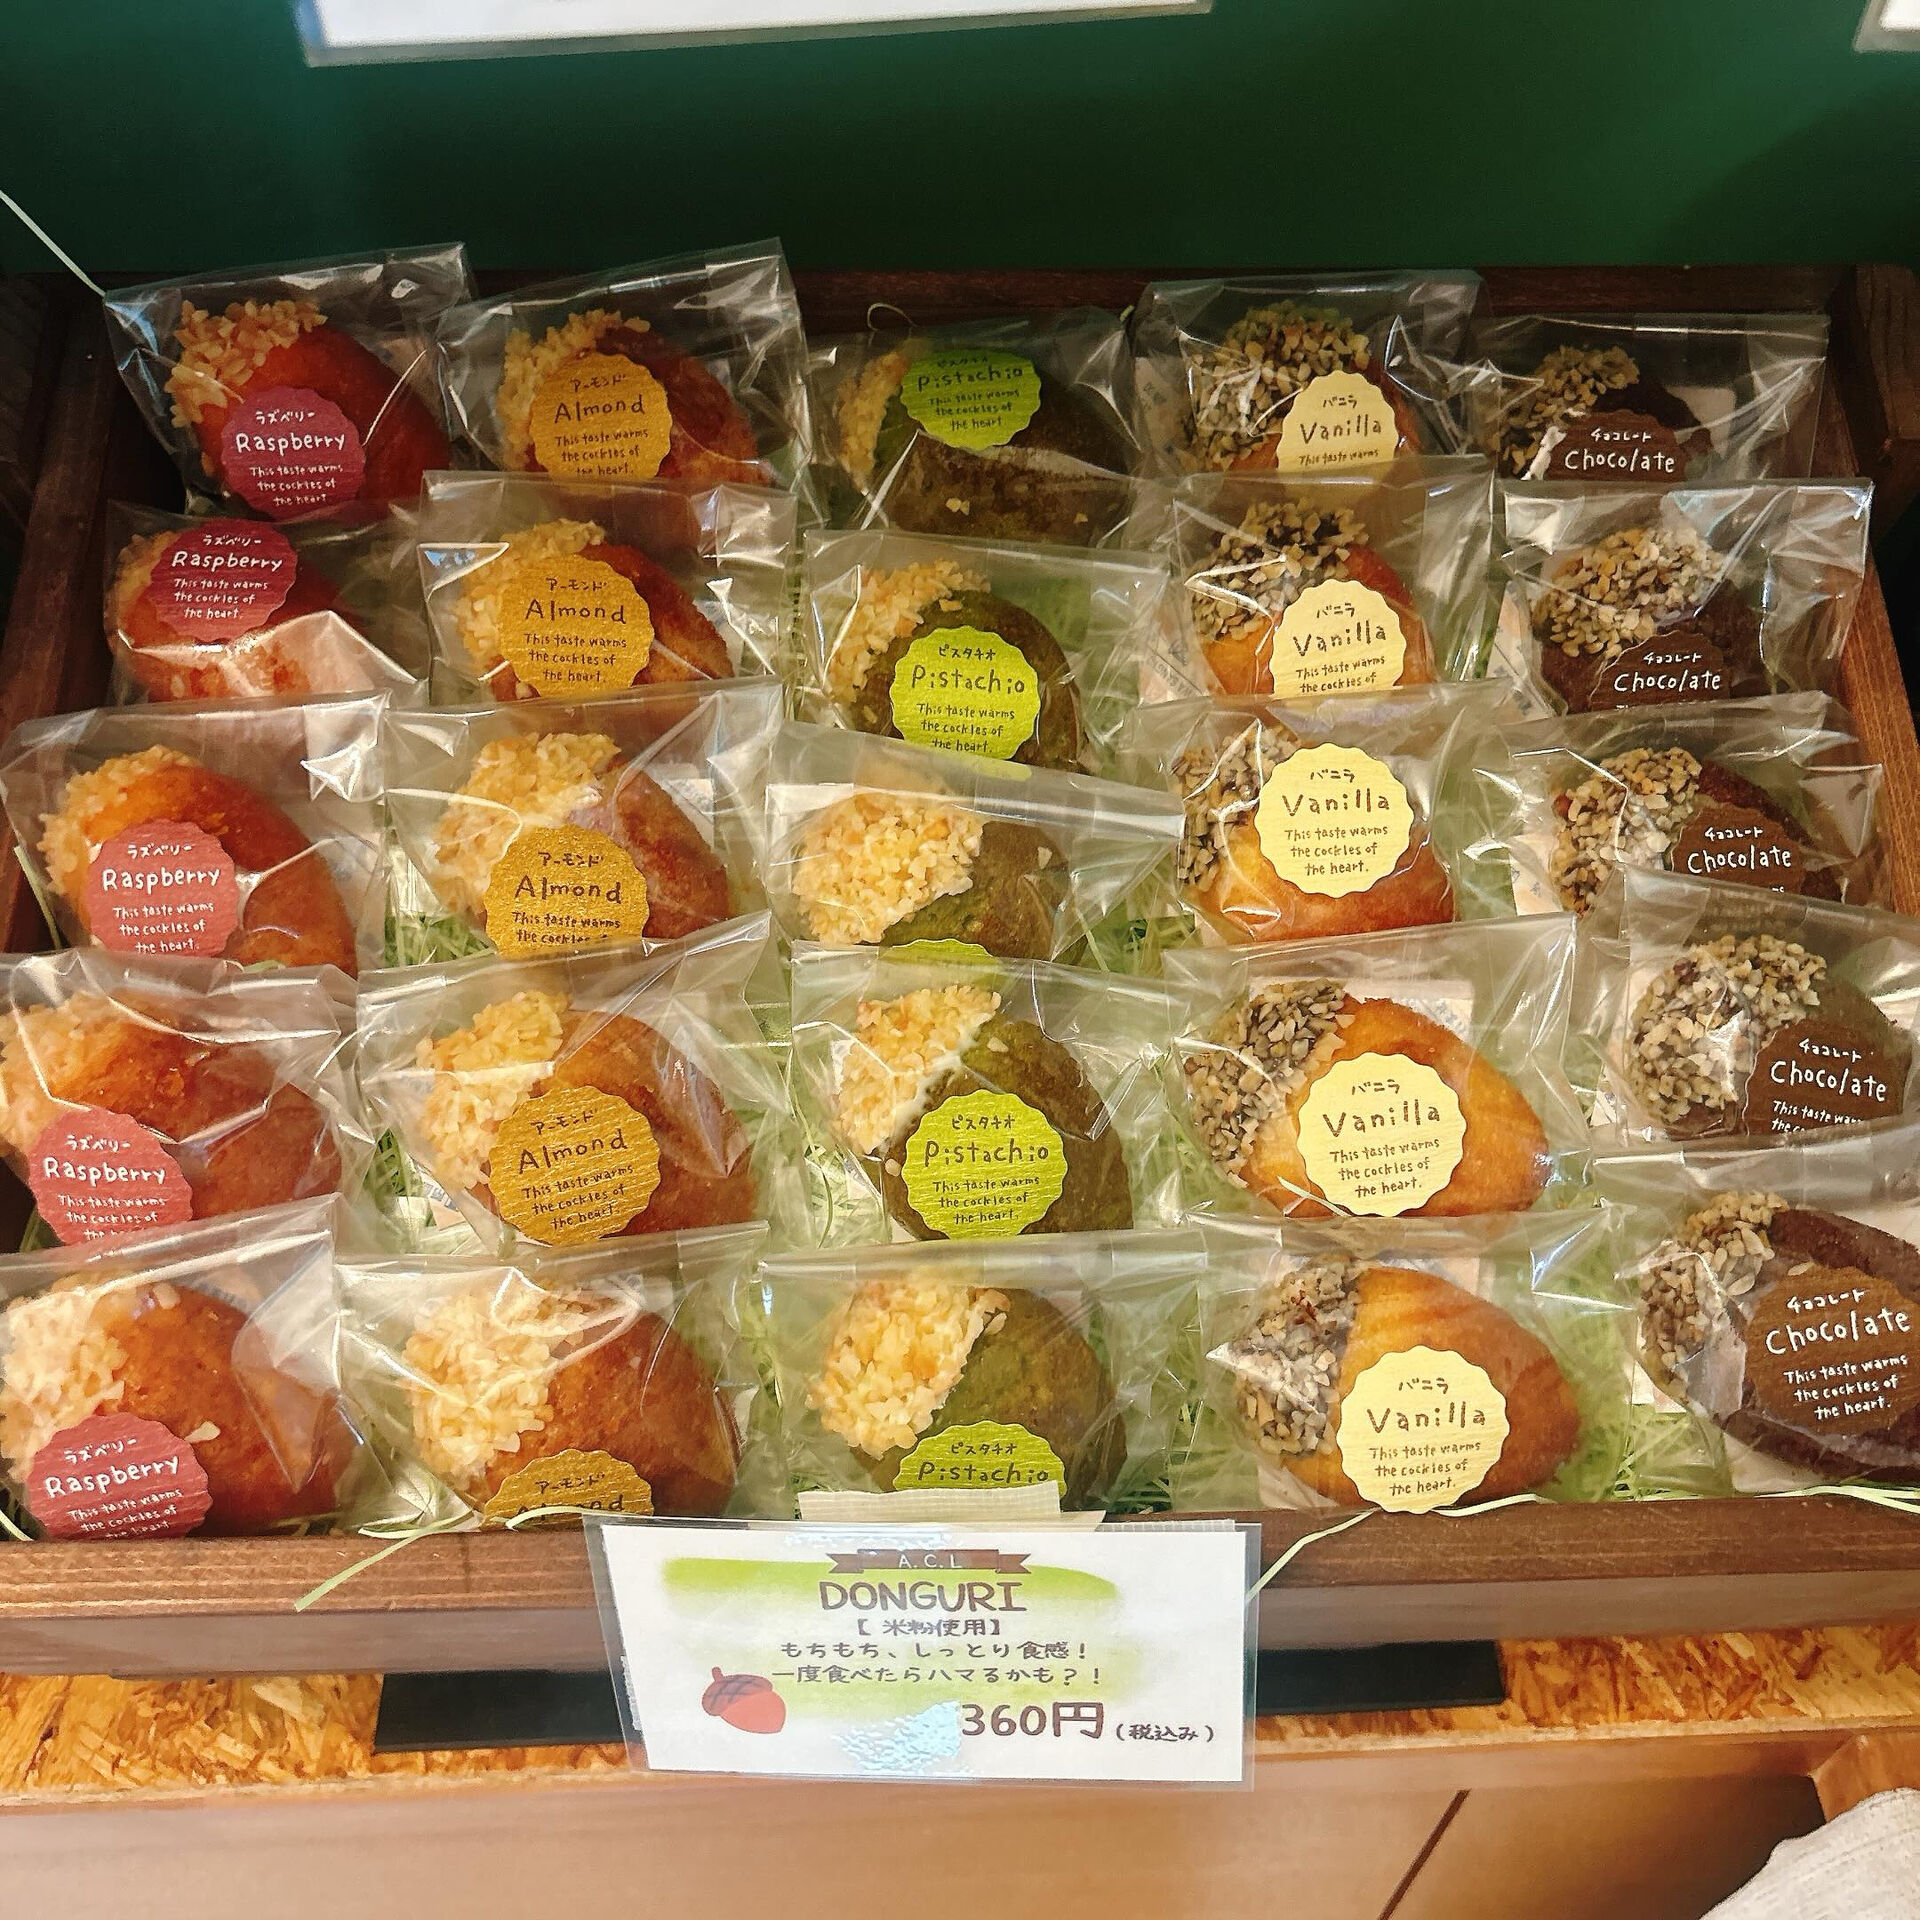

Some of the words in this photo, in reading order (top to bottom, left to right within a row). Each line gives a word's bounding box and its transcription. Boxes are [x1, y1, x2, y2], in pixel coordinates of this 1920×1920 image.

[917, 366, 1023, 392] Pistachio
[555, 395, 645, 423] Almond
[1323, 395, 1357, 408] バニラ
[256, 409, 315, 424] ラズベリー
[1300, 414, 1381, 444] Vanilla
[1590, 429, 1651, 442] チョコレート
[236, 433, 345, 456] Raspberry
[1565, 449, 1675, 473] Chocolate
[204, 535, 261, 546] ラズベリー
[172, 551, 282, 572] Raspberry
[174, 578, 197, 588] This
[233, 581, 268, 590] warms
[546, 577, 607, 591] アーモンド
[174, 593, 192, 601] the
[242, 594, 255, 604] of
[185, 607, 202, 617] the
[525, 599, 626, 624] Almond
[1316, 602, 1355, 618] バニラ
[524, 634, 550, 645] This
[553, 635, 585, 646] taste
[589, 637, 626, 648] warms
[1293, 620, 1386, 657] Vanilla
[529, 652, 548, 662] the
[552, 653, 598, 664] cockles
[602, 654, 616, 667] of
[939, 645, 996, 660] ピスタチオ
[1643, 652, 1702, 664] チョコレート
[543, 670, 562, 680] the
[1295, 668, 1320, 680] This
[1322, 664, 1349, 676] taste
[1353, 656, 1385, 668] warms
[912, 665, 1025, 693] Pistachio
[1299, 683, 1317, 693] the
[1365, 673, 1376, 685] of
[1614, 671, 1721, 692] Chocolate
[917, 703, 941, 714] This
[945, 704, 975, 717] taste
[979, 709, 1015, 719] warms
[921, 720, 939, 731] the
[942, 724, 986, 735] cockles
[990, 725, 1003, 737] of
[932, 739, 951, 749] the
[1310, 769, 1355, 783] バニラ
[1282, 788, 1389, 816] Vanilla
[1284, 829, 1310, 840] This
[1315, 828, 1345, 840] taste
[1349, 825, 1388, 836] warms
[1704, 826, 1763, 841] チョコレート
[128, 843, 193, 859] ラズベリー
[538, 851, 604, 867] アーモンド
[1291, 846, 1311, 857] the
[1314, 846, 1362, 857] cockles
[1366, 843, 1378, 855] of
[1687, 844, 1791, 873] Chocolate
[1305, 863, 1325, 875] the
[1330, 861, 1369, 874] heart.
[102, 867, 220, 894] Raspberry
[515, 875, 622, 904] Almond
[114, 907, 139, 919] This
[143, 905, 173, 916] taste
[177, 902, 214, 913] warms
[120, 924, 139, 936] the
[143, 923, 190, 935] cockles
[193, 920, 205, 932] of
[1798, 1038, 1861, 1063] チョコレート
[1352, 1079, 1400, 1095] バニラ
[1770, 1060, 1887, 1103] Chocolate
[1323, 1099, 1441, 1137] Vanilla
[1773, 1100, 1798, 1116] This
[1801, 1106, 1831, 1121] taste
[530, 1110, 597, 1136] アーモンド
[951, 1114, 1015, 1130] ピスタチオ
[65, 1135, 130, 1151] ラズベリー
[518, 1128, 628, 1174] Almond
[924, 1138, 1049, 1166] Pistachio
[1330, 1151, 1358, 1163] This
[1361, 1144, 1395, 1158] taste
[1398, 1139, 1440, 1154] warms
[43, 1157, 165, 1187] Raspberry
[1338, 1168, 1360, 1180] the
[1364, 1162, 1412, 1176] cockles
[1418, 1157, 1430, 1170] of
[522, 1186, 551, 1200] This
[555, 1177, 589, 1192] taste
[593, 1165, 634, 1183] warms
[932, 1181, 960, 1193] This
[963, 1179, 996, 1189] taste
[1000, 1176, 1040, 1186] warms
[1355, 1186, 1377, 1198] the
[1382, 1178, 1422, 1193] heart.
[532, 1203, 553, 1215] the
[557, 1191, 609, 1212] cockles
[613, 1183, 625, 1197] of
[939, 1197, 960, 1207] the
[964, 1195, 1011, 1206] cockles
[1015, 1192, 1029, 1203] of
[551, 1217, 573, 1230] the
[953, 1214, 975, 1224] the
[1786, 1288, 1864, 1314] チョコレート
[1765, 1308, 1910, 1355] Chocolate
[1783, 1370, 1816, 1385] This
[1820, 1364, 1857, 1380] taste
[1861, 1354, 1908, 1372] warms
[1398, 1377, 1448, 1394] バニラ
[1794, 1389, 1819, 1402] the
[1823, 1380, 1879, 1399] cockles
[1883, 1374, 1898, 1388] of
[1367, 1401, 1486, 1433] Vanilla
[1814, 1406, 1840, 1419] the
[1844, 1395, 1891, 1415] heart.
[64, 1436, 136, 1464] ラズベリー
[950, 1443, 1018, 1455] ピスタチオ
[1369, 1446, 1398, 1460] This
[1402, 1444, 1437, 1457] taste
[1441, 1441, 1480, 1453] warms
[45, 1455, 180, 1499] Raspberry
[918, 1462, 1049, 1483] Pistachio
[1375, 1466, 1397, 1477] the
[1401, 1465, 1451, 1477] cockles
[1455, 1460, 1468, 1471] of
[535, 1473, 605, 1492] アーモンド
[1389, 1484, 1412, 1496] the
[1417, 1479, 1456, 1494] heart.
[69, 1507, 98, 1520] This
[101, 1501, 136, 1514] taste
[141, 1488, 183, 1504] warms
[81, 1522, 103, 1532] the
[165, 1505, 178, 1516] of
[819, 1581, 1027, 1613] DONGURI
[961, 1701, 1104, 1739] 360円
